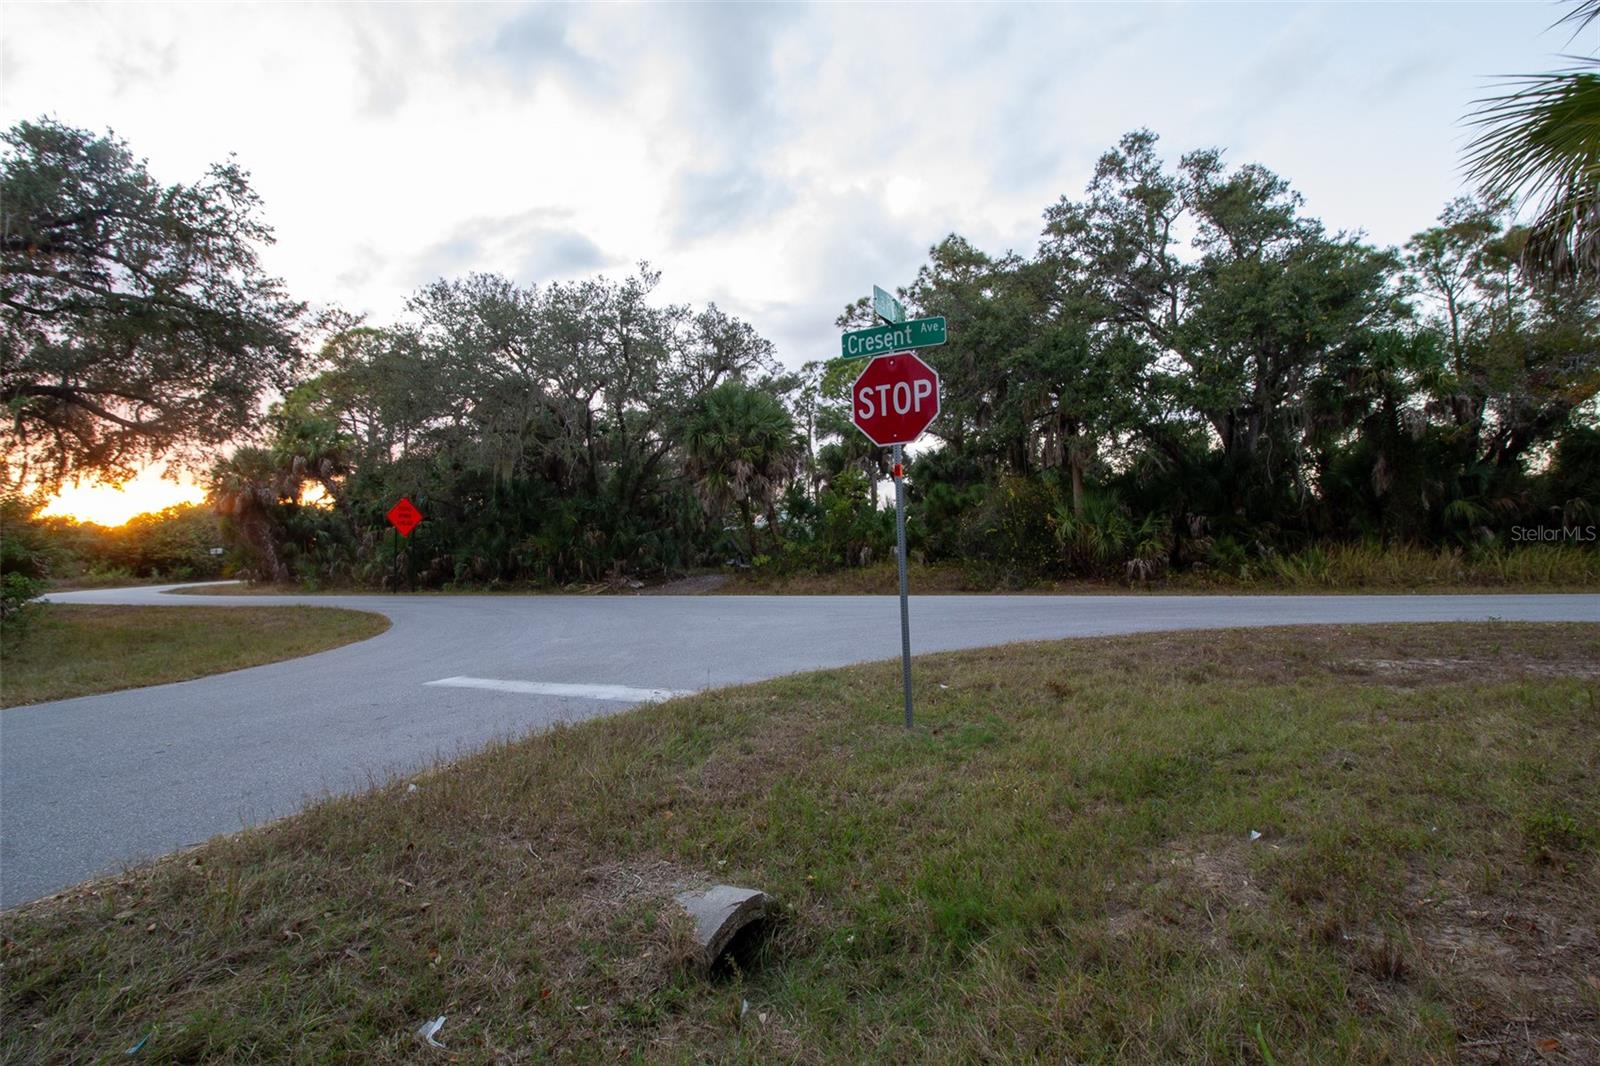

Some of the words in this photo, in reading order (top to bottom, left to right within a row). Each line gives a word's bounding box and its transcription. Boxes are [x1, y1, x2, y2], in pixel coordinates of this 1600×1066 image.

[847, 325, 913, 354] Cresent
[920, 321, 939, 333] Ave
[858, 379, 932, 420] STOP
